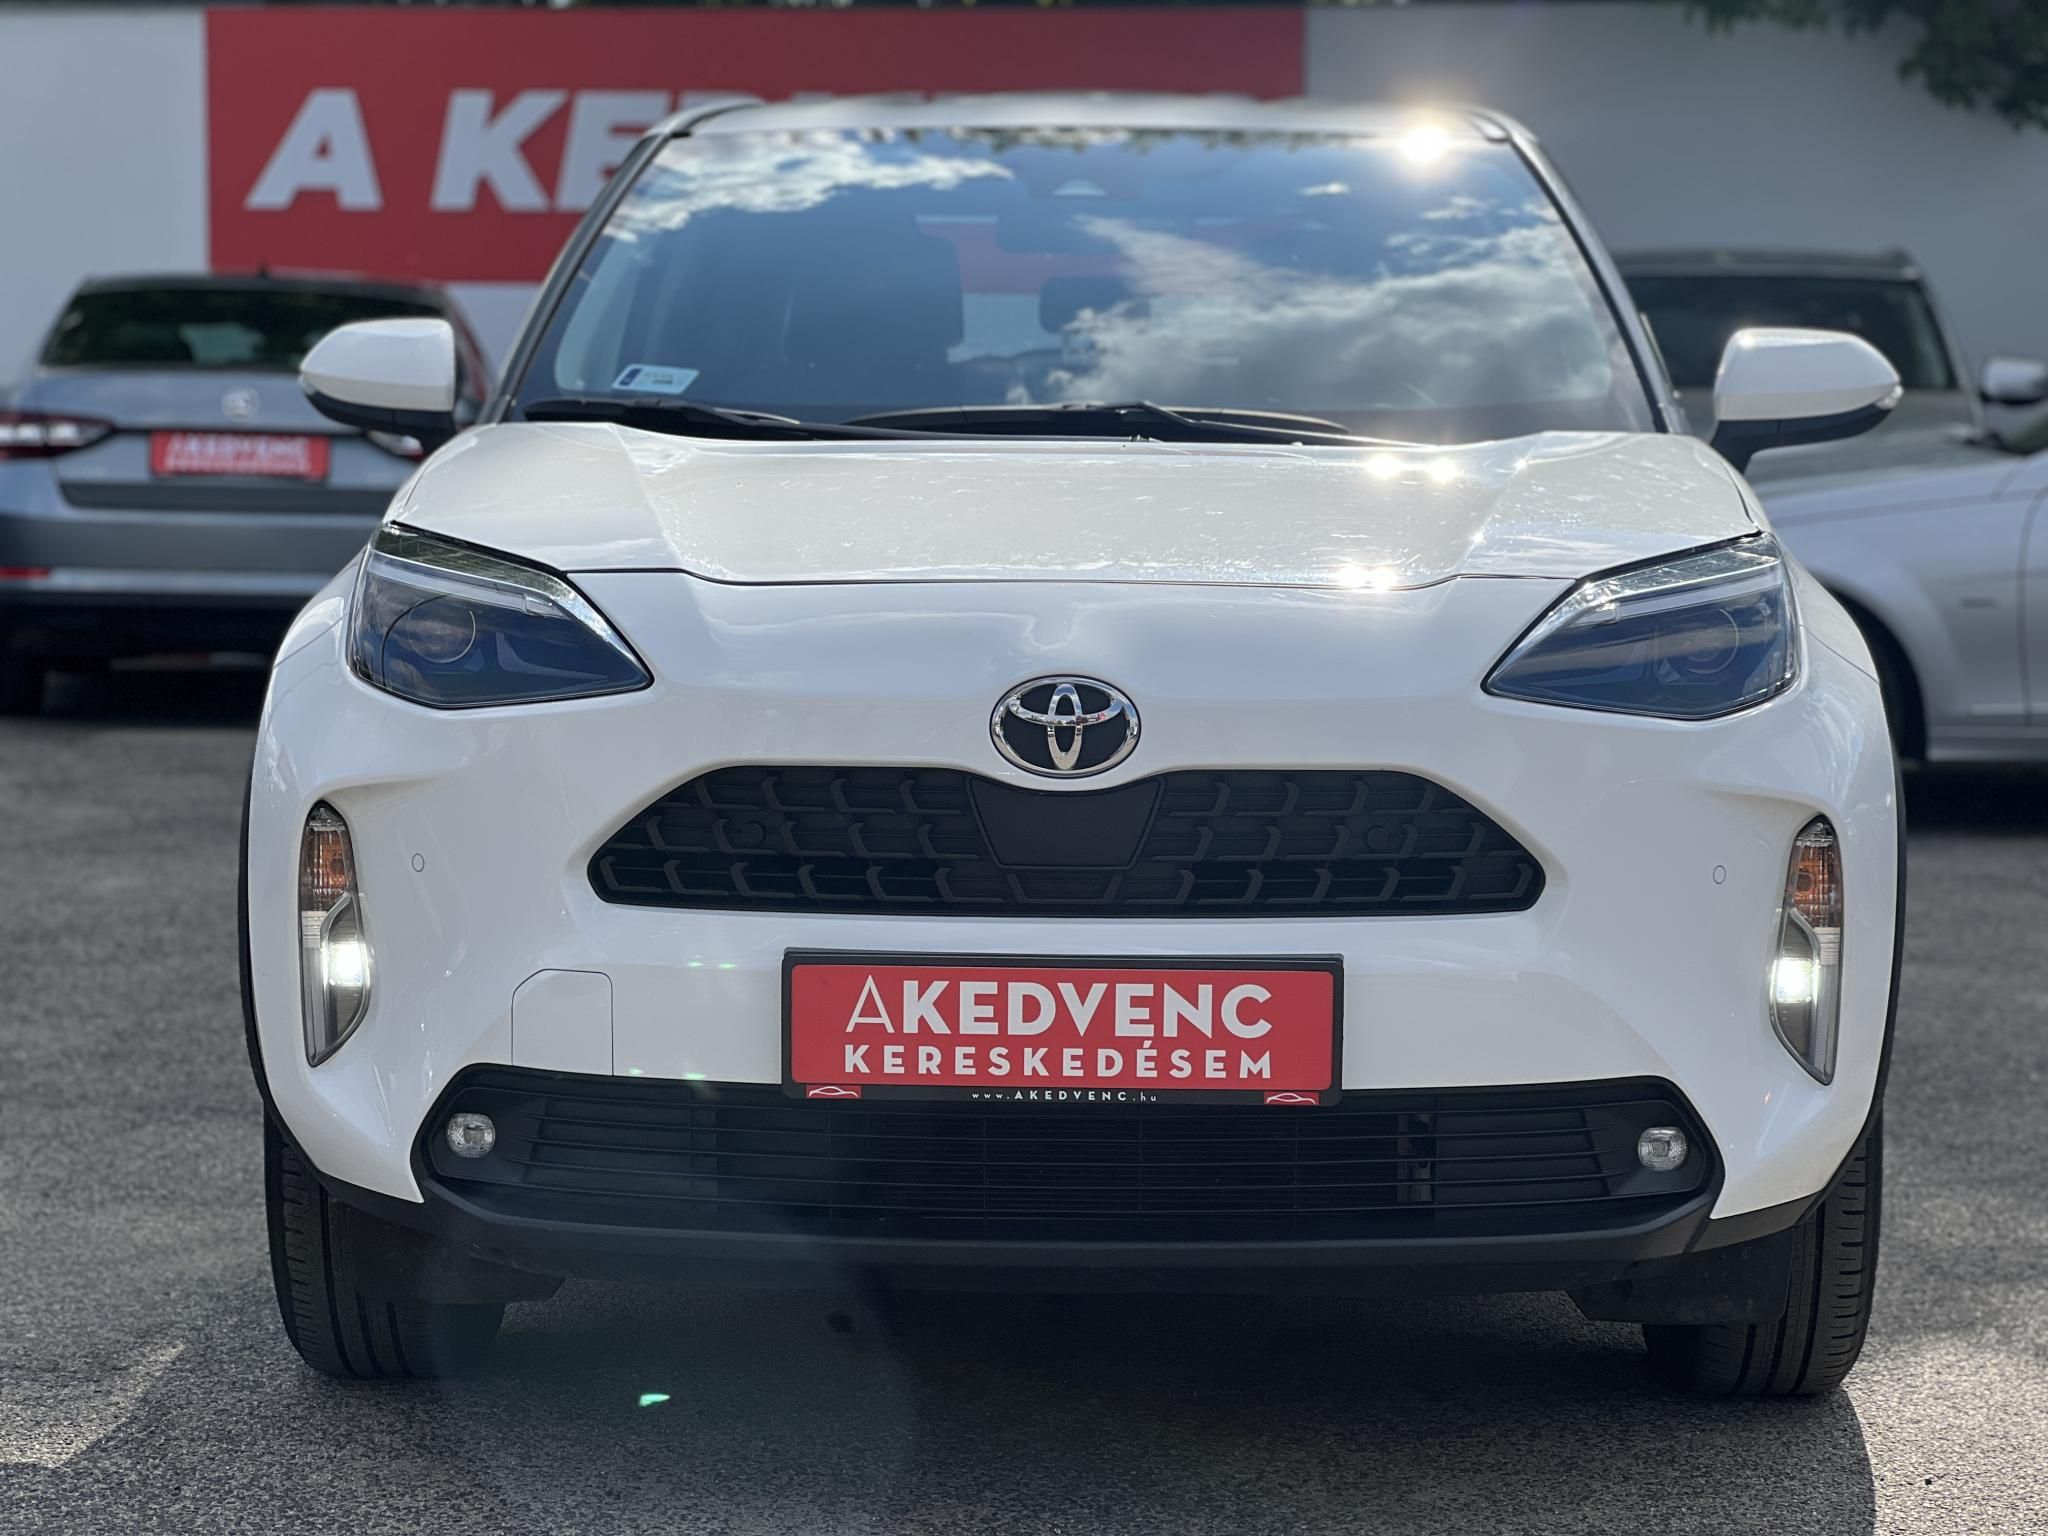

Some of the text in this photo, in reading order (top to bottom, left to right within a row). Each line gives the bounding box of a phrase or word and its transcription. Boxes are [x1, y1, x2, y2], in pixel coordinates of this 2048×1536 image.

[244, 88, 383, 211] A
[844, 1041, 1271, 1079] KERESKEDÉSEM
[971, 1090, 1157, 1102] www.AKEDVENC.hu
